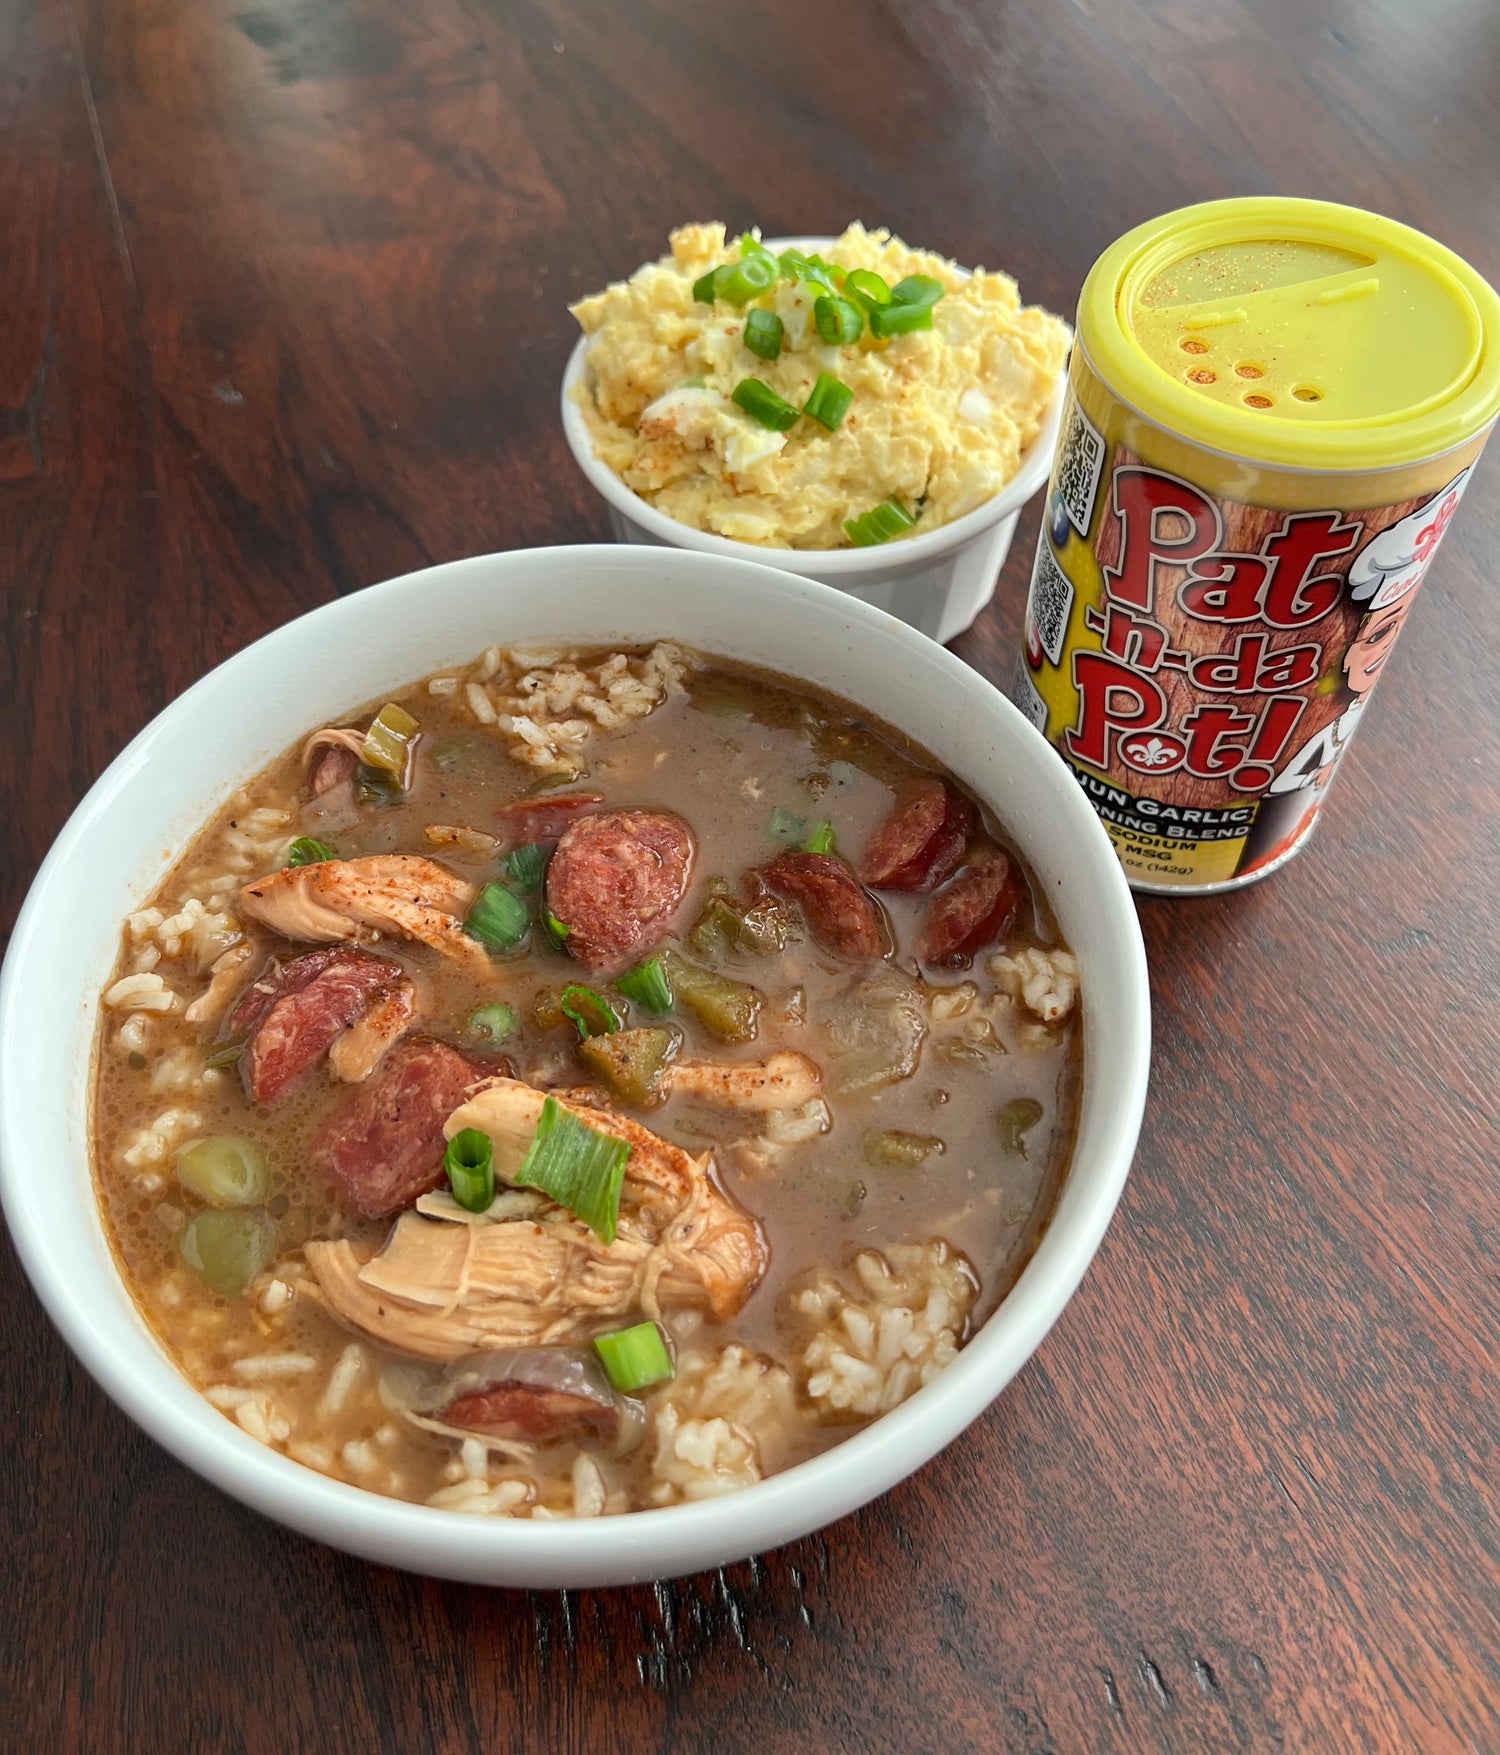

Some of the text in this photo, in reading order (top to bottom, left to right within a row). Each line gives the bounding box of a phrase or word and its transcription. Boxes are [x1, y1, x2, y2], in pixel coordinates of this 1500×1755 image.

[1104, 465, 1362, 628] Pat
[1066, 649, 1307, 792] Pot!
[1108, 825, 1197, 850] SODIUM
[1125, 845, 1173, 861] MSG
[1147, 862, 1194, 875] (142g)
